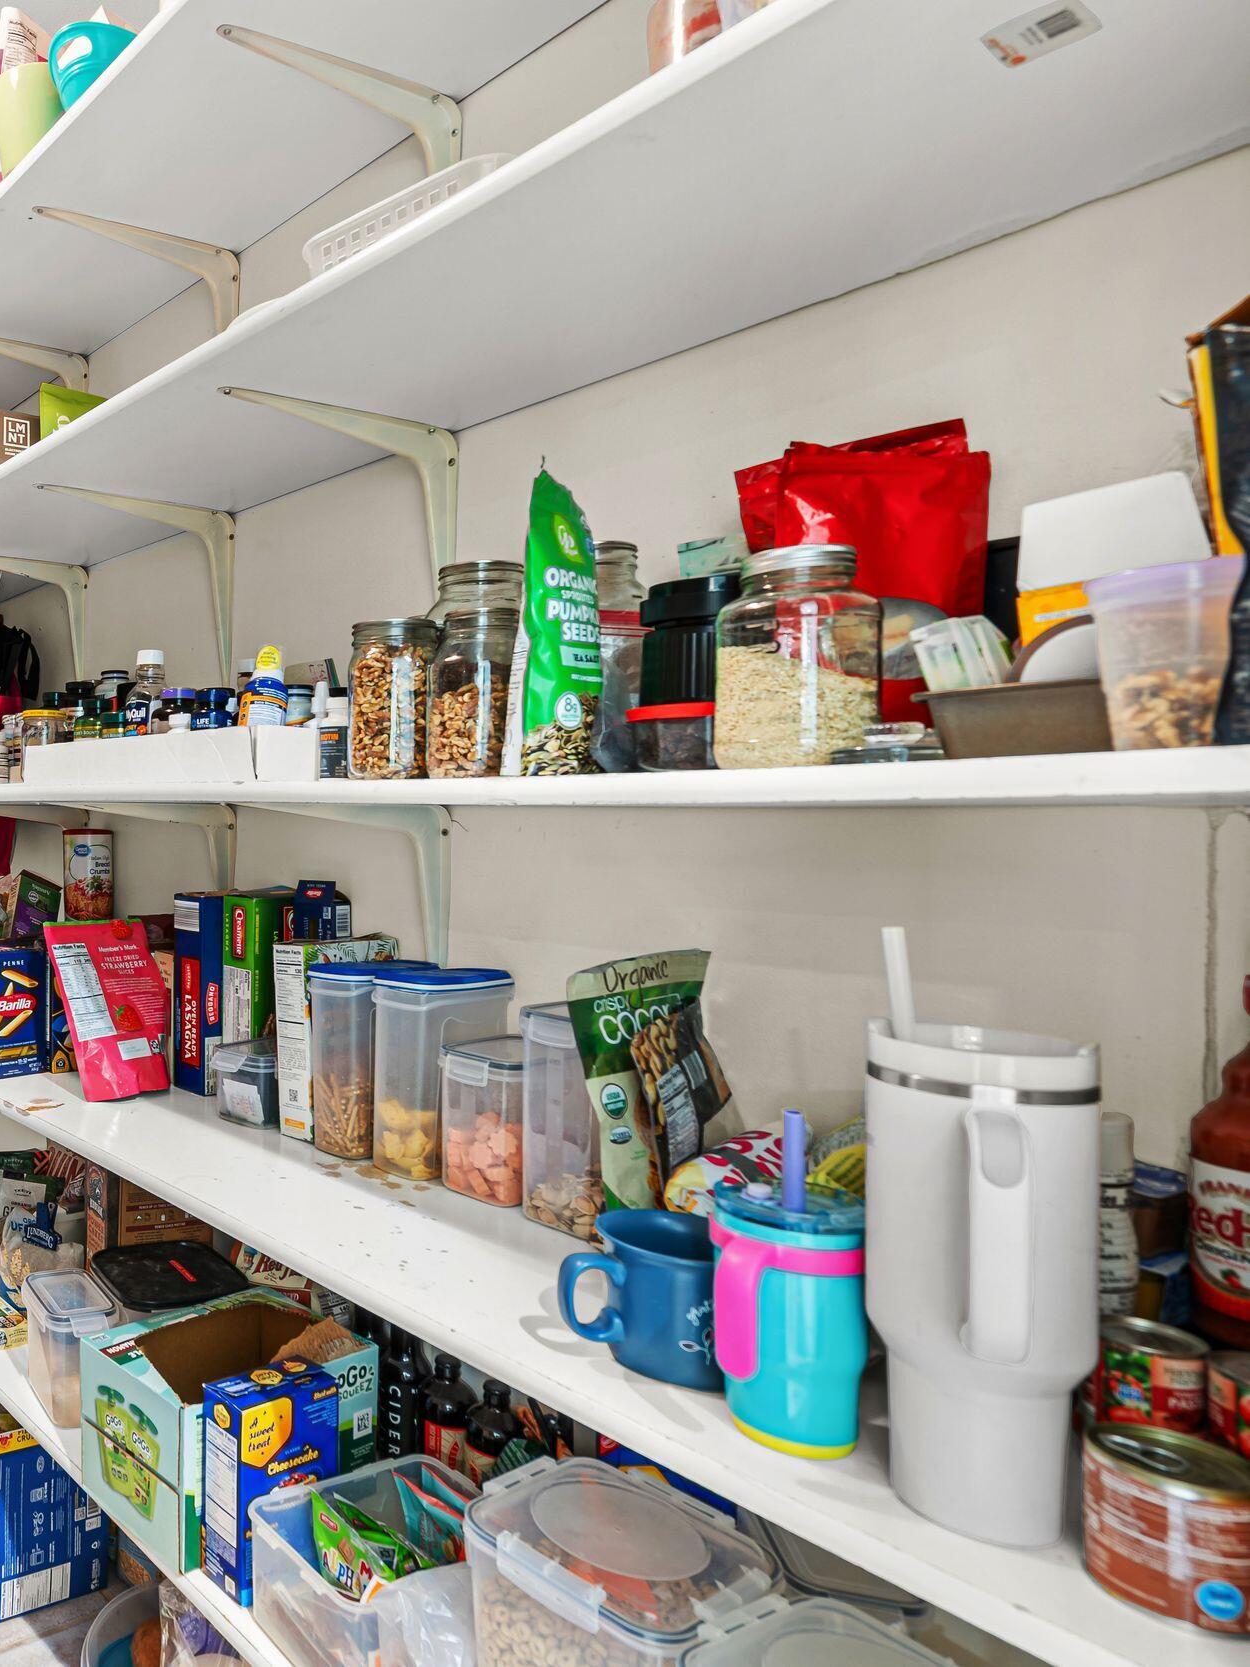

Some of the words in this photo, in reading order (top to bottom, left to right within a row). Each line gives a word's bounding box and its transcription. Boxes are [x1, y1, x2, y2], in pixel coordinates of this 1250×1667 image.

[8, 421, 26, 433] LM
[8, 433, 26, 444] NT
[196, 717, 210, 725] LIFE
[2, 959, 25, 967] PENNE
[100, 960, 147, 970] STRAWBERRY
[602, 959, 669, 1009] Organic
[184, 994, 192, 1059] LASAGNA
[388, 1385, 402, 1455] CIDER
[250, 1422, 275, 1440] sweet
[248, 1437, 271, 1453] treat
[267, 1448, 319, 1475] Cheesecake
